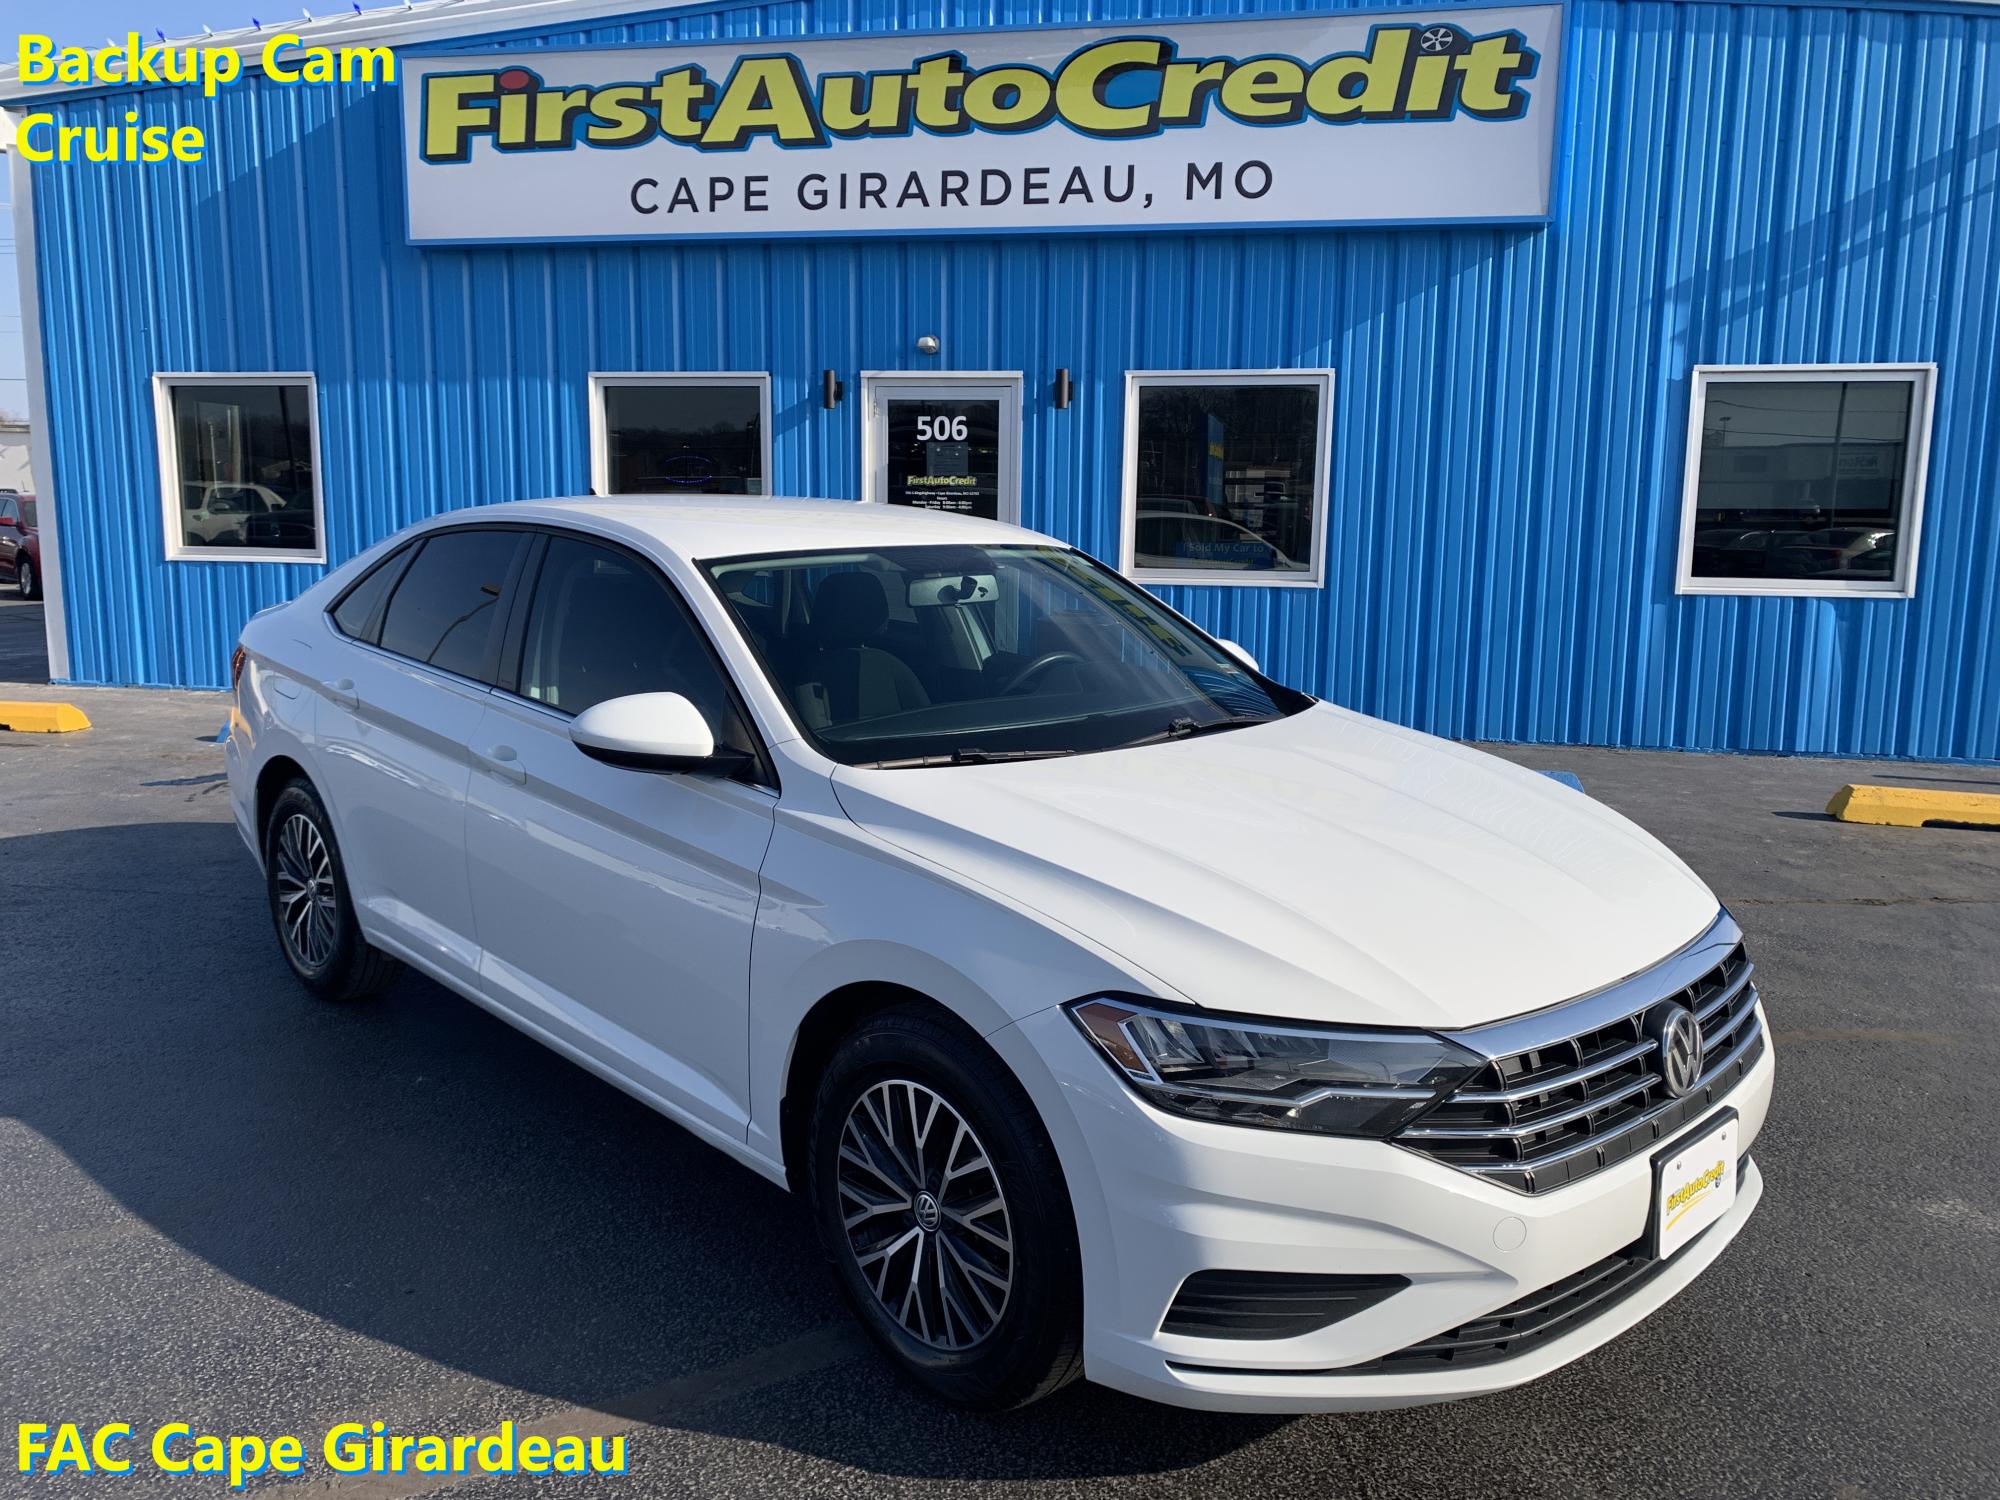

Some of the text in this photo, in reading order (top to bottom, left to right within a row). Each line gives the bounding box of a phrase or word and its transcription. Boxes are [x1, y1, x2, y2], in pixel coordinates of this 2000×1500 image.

[420, 23, 1541, 164] FirstAutoCredit
[630, 160, 1273, 214] CAPE GIRARDEAU, MO
[916, 415, 968, 441] 506
[907, 475, 977, 486] FirstAutoCredit
[1189, 543, 1211, 552] Sold
[1214, 544, 1230, 554] My
[1233, 543, 1249, 552] Car
[1254, 543, 1264, 552] to
